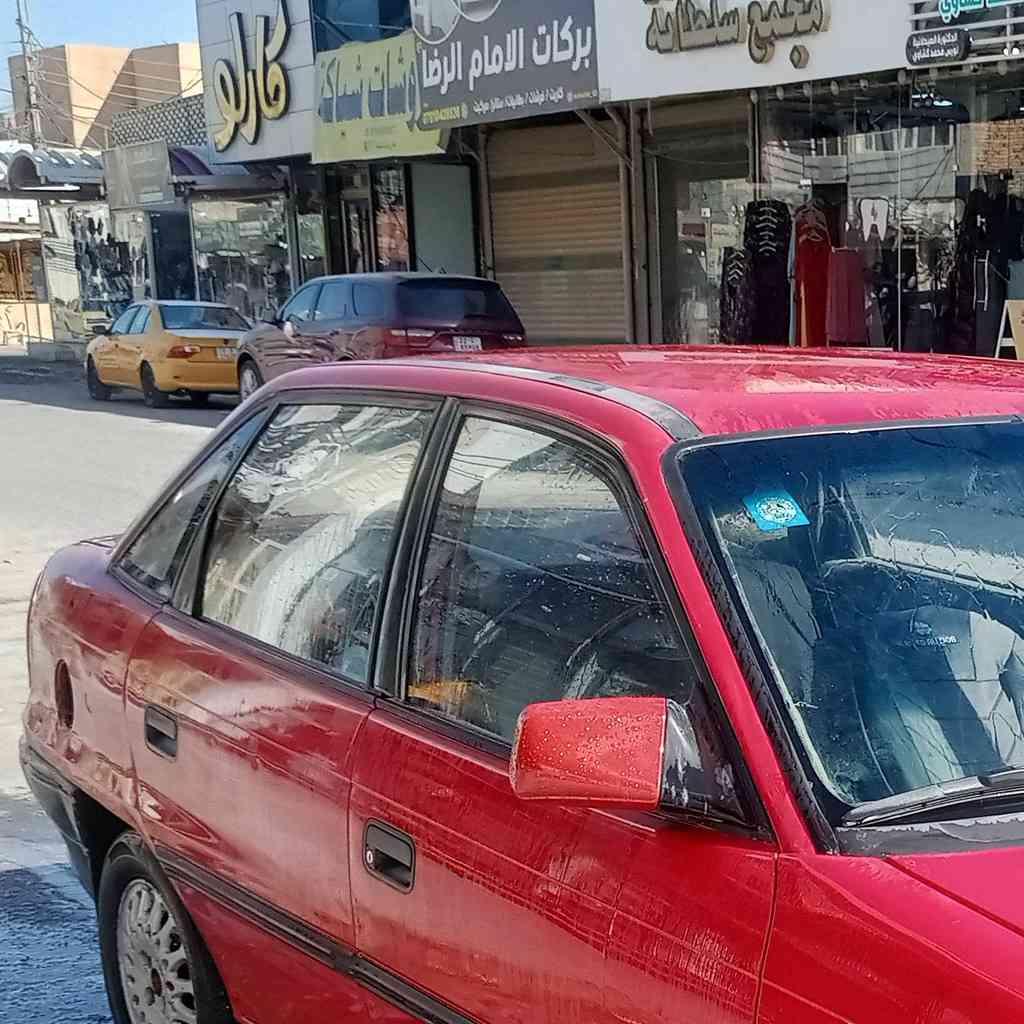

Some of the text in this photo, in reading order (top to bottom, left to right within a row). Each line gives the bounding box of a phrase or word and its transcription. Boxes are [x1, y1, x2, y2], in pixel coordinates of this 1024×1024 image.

[214, 0, 291, 152] كارلو
[421, 15, 592, 95] بركات الامام الرضا
